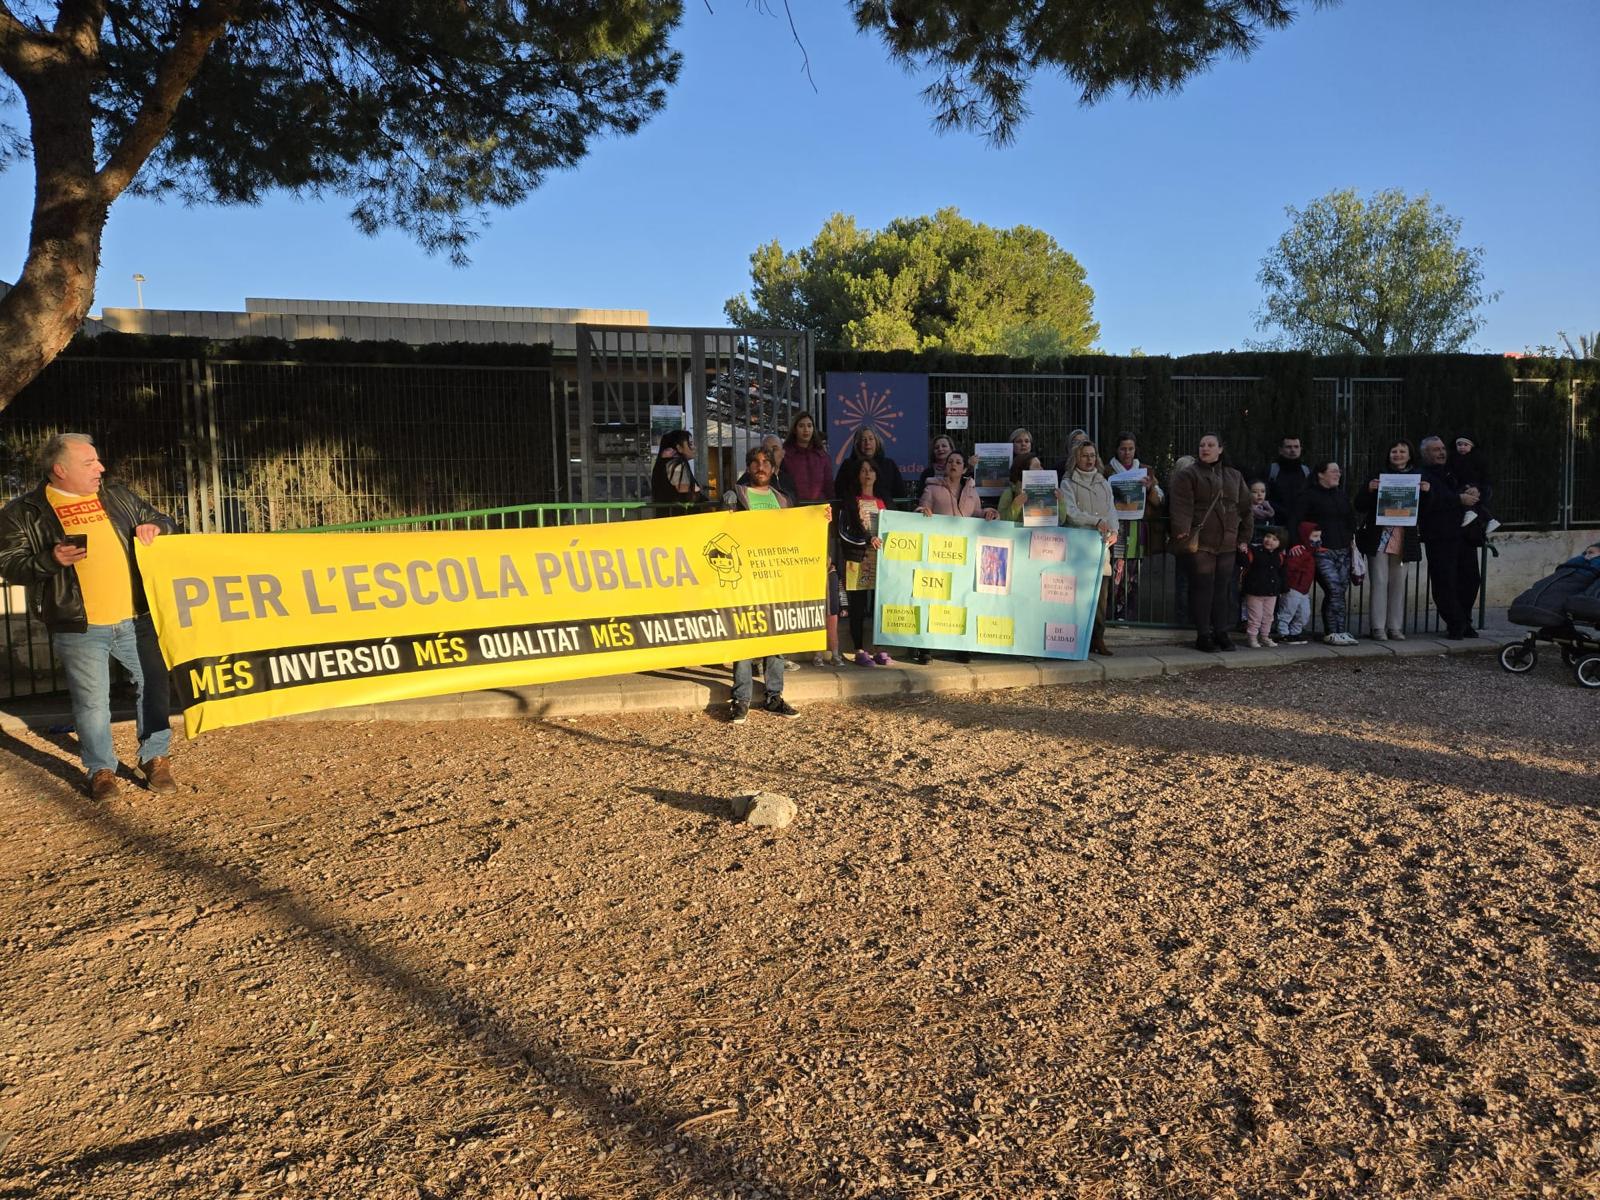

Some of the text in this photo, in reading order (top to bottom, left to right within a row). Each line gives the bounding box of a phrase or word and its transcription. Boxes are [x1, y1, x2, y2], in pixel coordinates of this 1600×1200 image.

[890, 538, 917, 550] SON
[747, 546, 800, 558] PLATAFORMA
[933, 551, 963, 560] MESES
[750, 560, 766, 569] PER
[172, 538, 699, 628] PER L'ESCOLA PÚBLICA
[921, 577, 944, 588] SIN
[190, 604, 826, 699] MÉS INVERSIÓ MÉS QUALITAT MÉS VALENCIÀ MÉS DIGNITAT
